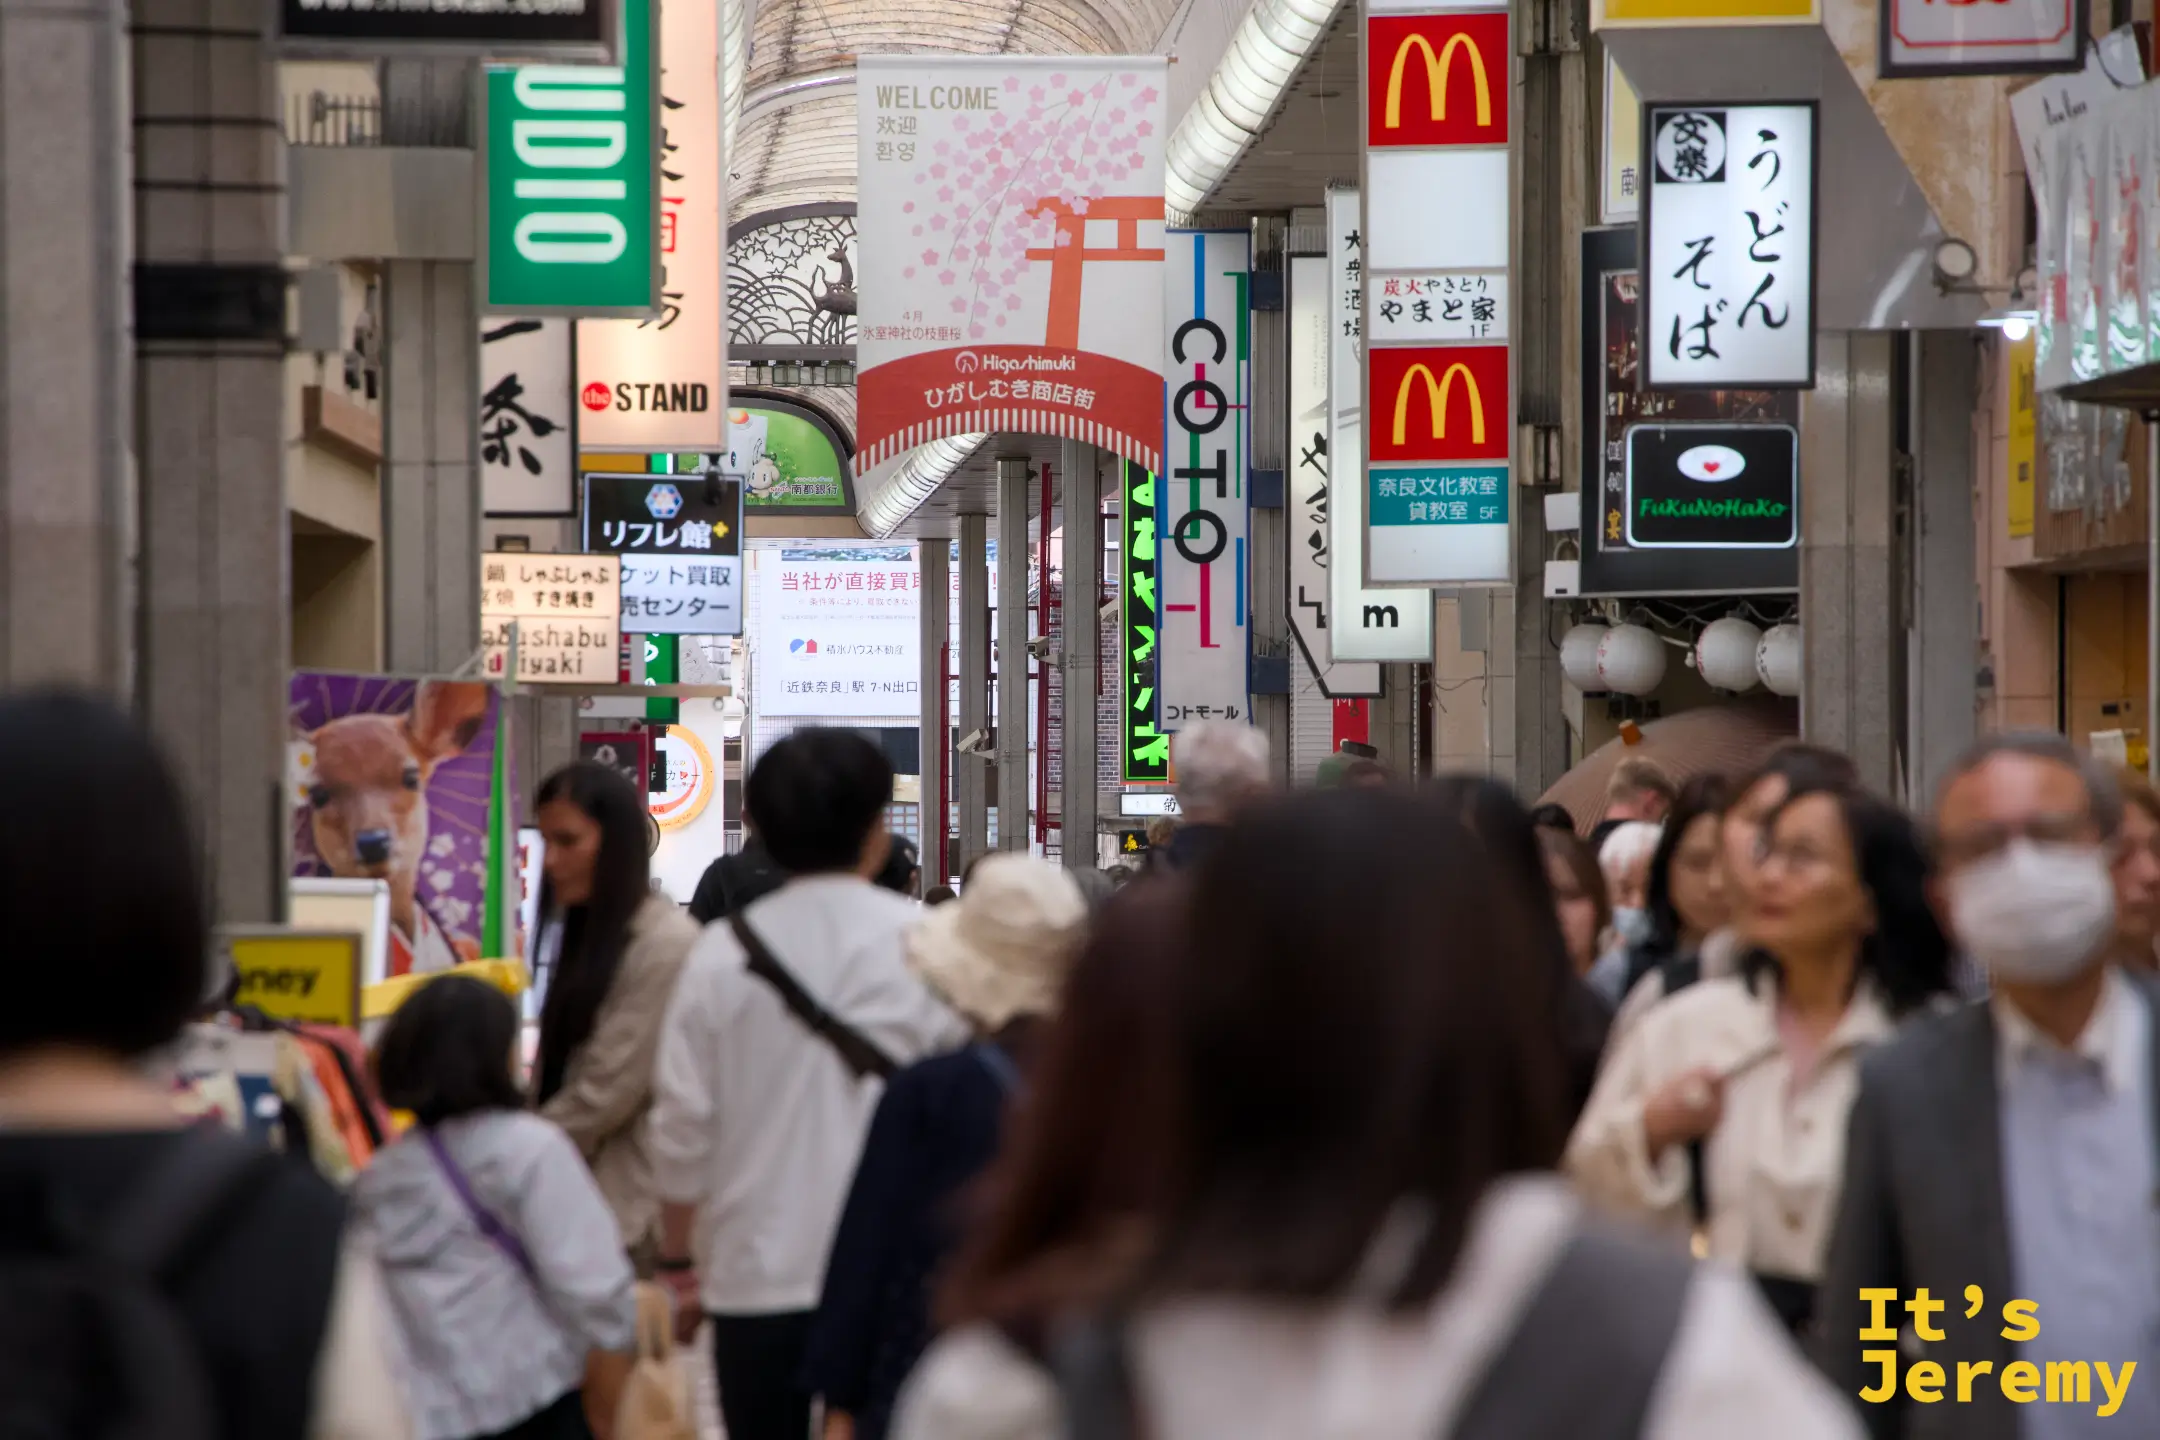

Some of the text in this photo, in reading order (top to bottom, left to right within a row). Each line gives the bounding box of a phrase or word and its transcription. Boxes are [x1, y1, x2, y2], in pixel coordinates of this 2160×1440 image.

[876, 86, 999, 110] WELCOME
[876, 115, 917, 136] 欢迎
[876, 141, 916, 162] 환영
[1738, 129, 1789, 329] うどん
[1384, 276, 1487, 297] 炭火やきとり
[1670, 236, 1728, 360] そば
[902, 311, 922, 322] 4月
[1380, 297, 1496, 323] やまと家
[863, 326, 962, 341] 氷室神社の枝垂桜
[1470, 324, 1490, 338] 1F
[983, 355, 1076, 375] Higashimuki
[616, 382, 708, 412] STAND
[924, 378, 1096, 410] ひがしむき商店街
[1172, 318, 1228, 563] COTO
[791, 484, 838, 495] 南都銀行
[1378, 476, 1498, 497] 奈良文化教室
[1409, 501, 1498, 521] 貸教室 5F
[1639, 497, 1789, 519] FuKuNoHaKo
[520, 565, 610, 584] しゃぶしゃぶ
[1167, 705, 1239, 720] コトモール
